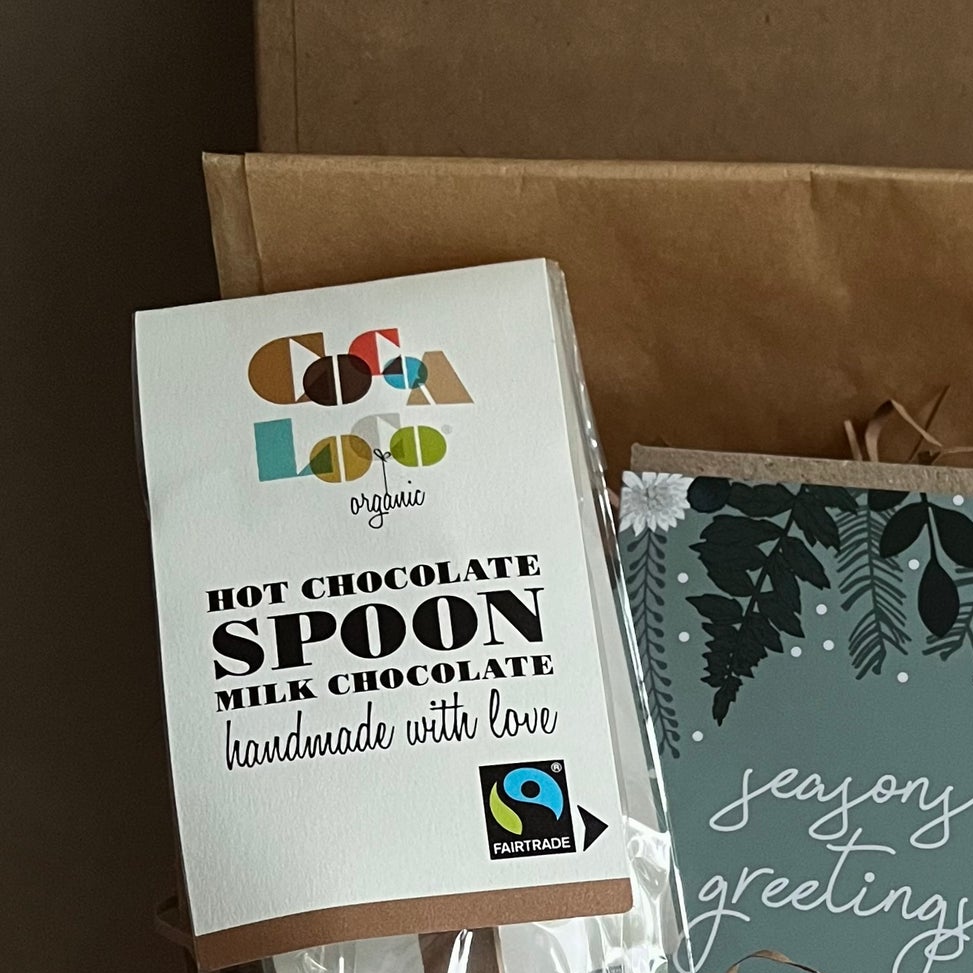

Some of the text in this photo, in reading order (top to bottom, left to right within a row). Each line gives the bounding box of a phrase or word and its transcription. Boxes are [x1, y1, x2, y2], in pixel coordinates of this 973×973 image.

[247, 327, 475, 407] COCOA
[253, 412, 448, 483] LOCO
[350, 480, 426, 530] organic
[205, 554, 542, 613] HOT CHOCOLATE
[212, 587, 545, 680] SPOON
[214, 654, 554, 713] MILK CHOCOLATE
[225, 688, 558, 771] handmade with love
[493, 836, 571, 855] FAIRTRADE
